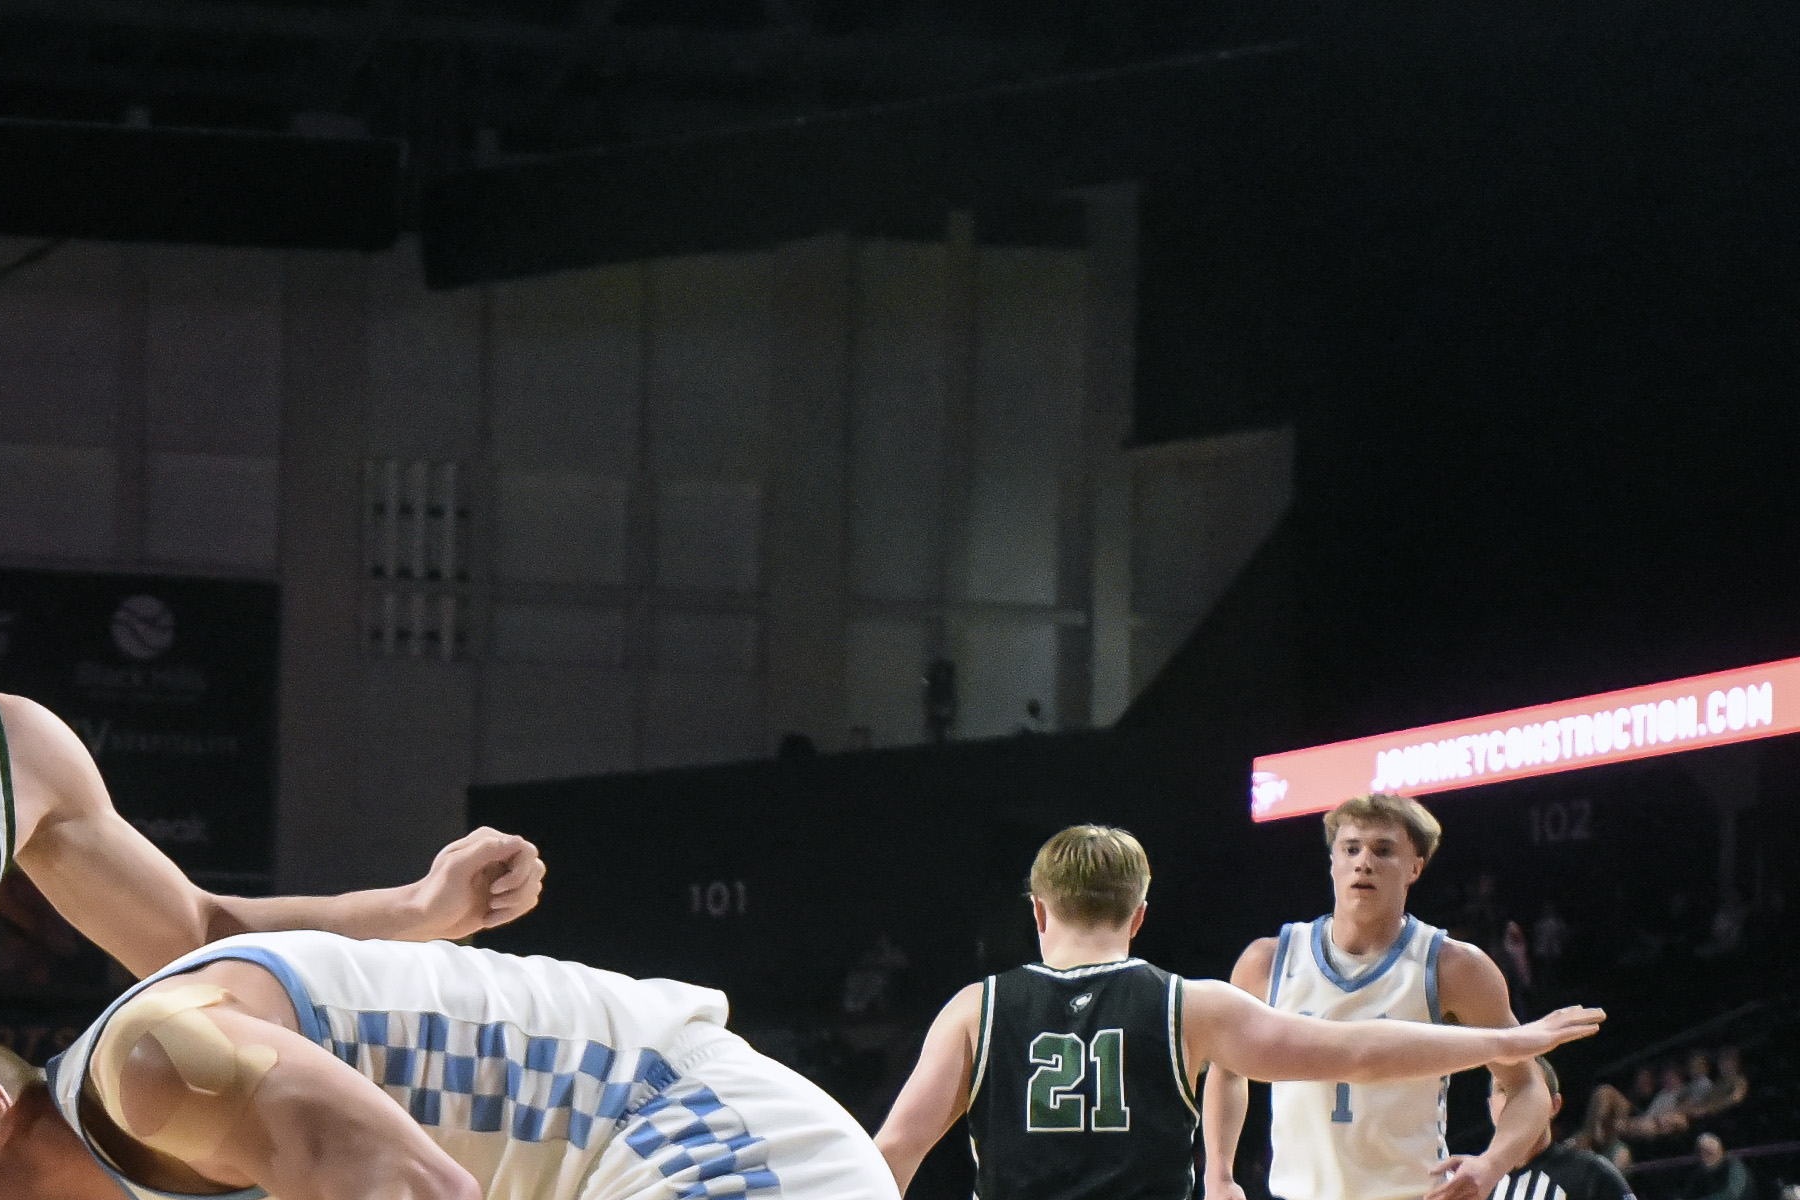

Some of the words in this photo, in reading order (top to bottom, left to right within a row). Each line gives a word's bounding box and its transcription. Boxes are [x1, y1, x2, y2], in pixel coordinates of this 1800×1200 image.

[1371, 681, 1773, 791] JOURNEYCONSTRUCTION.COM
[1528, 797, 1593, 846] 102
[688, 880, 749, 917] 101
[1026, 1028, 1130, 1132] 21
[1330, 1081, 1353, 1123] 1
